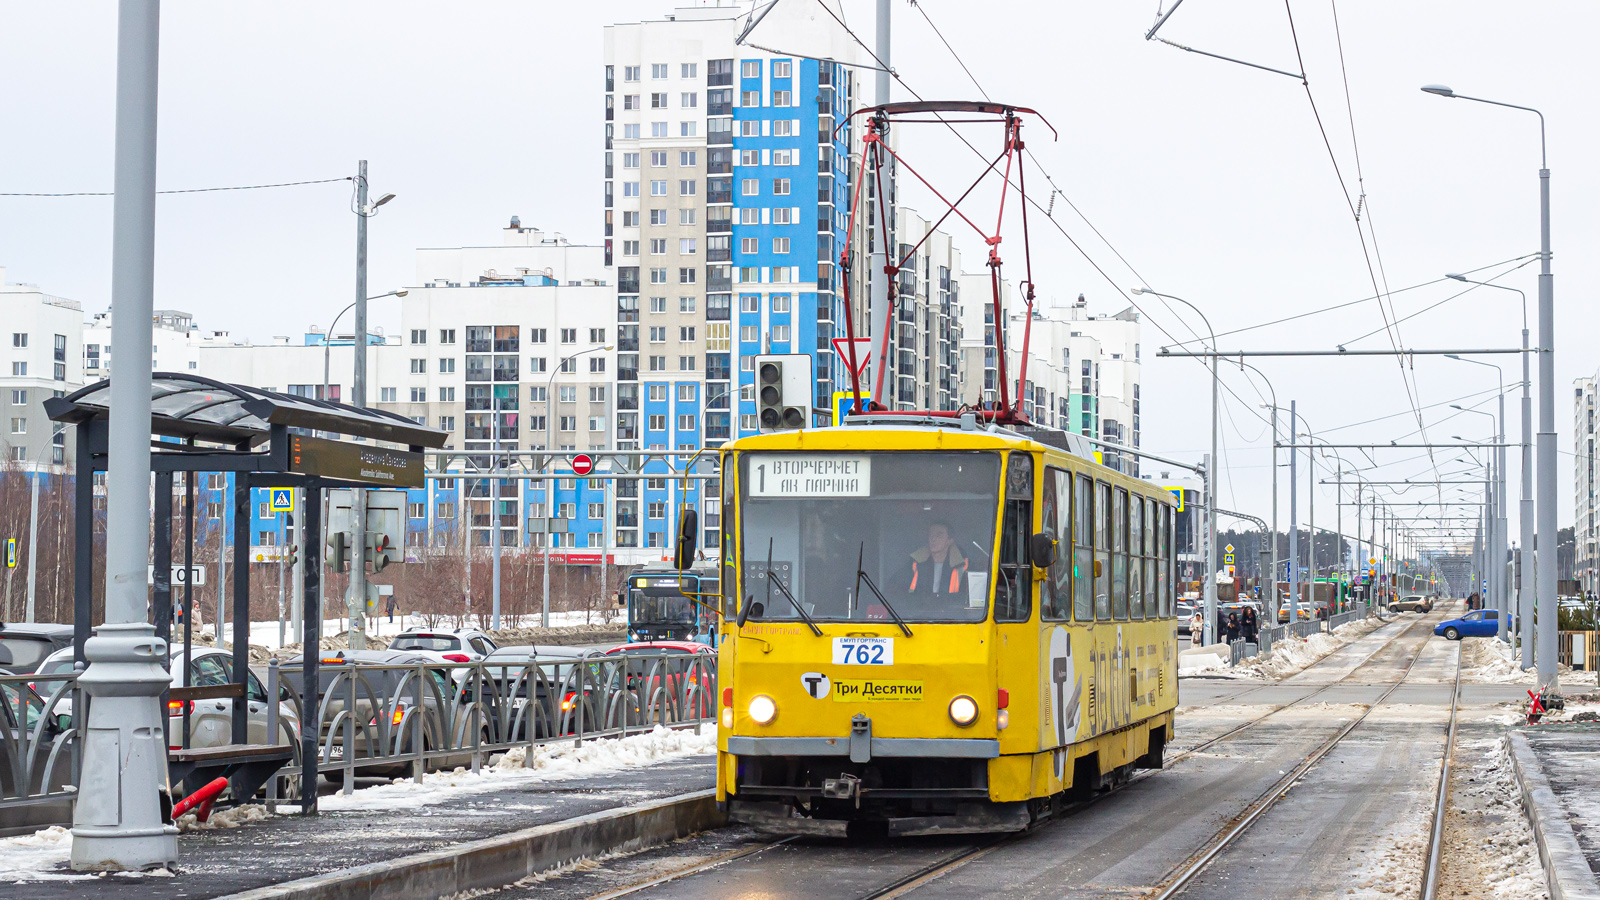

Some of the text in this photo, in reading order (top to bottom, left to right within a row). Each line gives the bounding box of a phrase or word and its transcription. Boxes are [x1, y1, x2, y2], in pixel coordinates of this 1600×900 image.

[773, 461, 860, 474] ВТОРЧЕРМЕТ
[757, 464, 765, 493] 1
[841, 644, 884, 664] 762
[833, 681, 922, 696] Три Десятки
